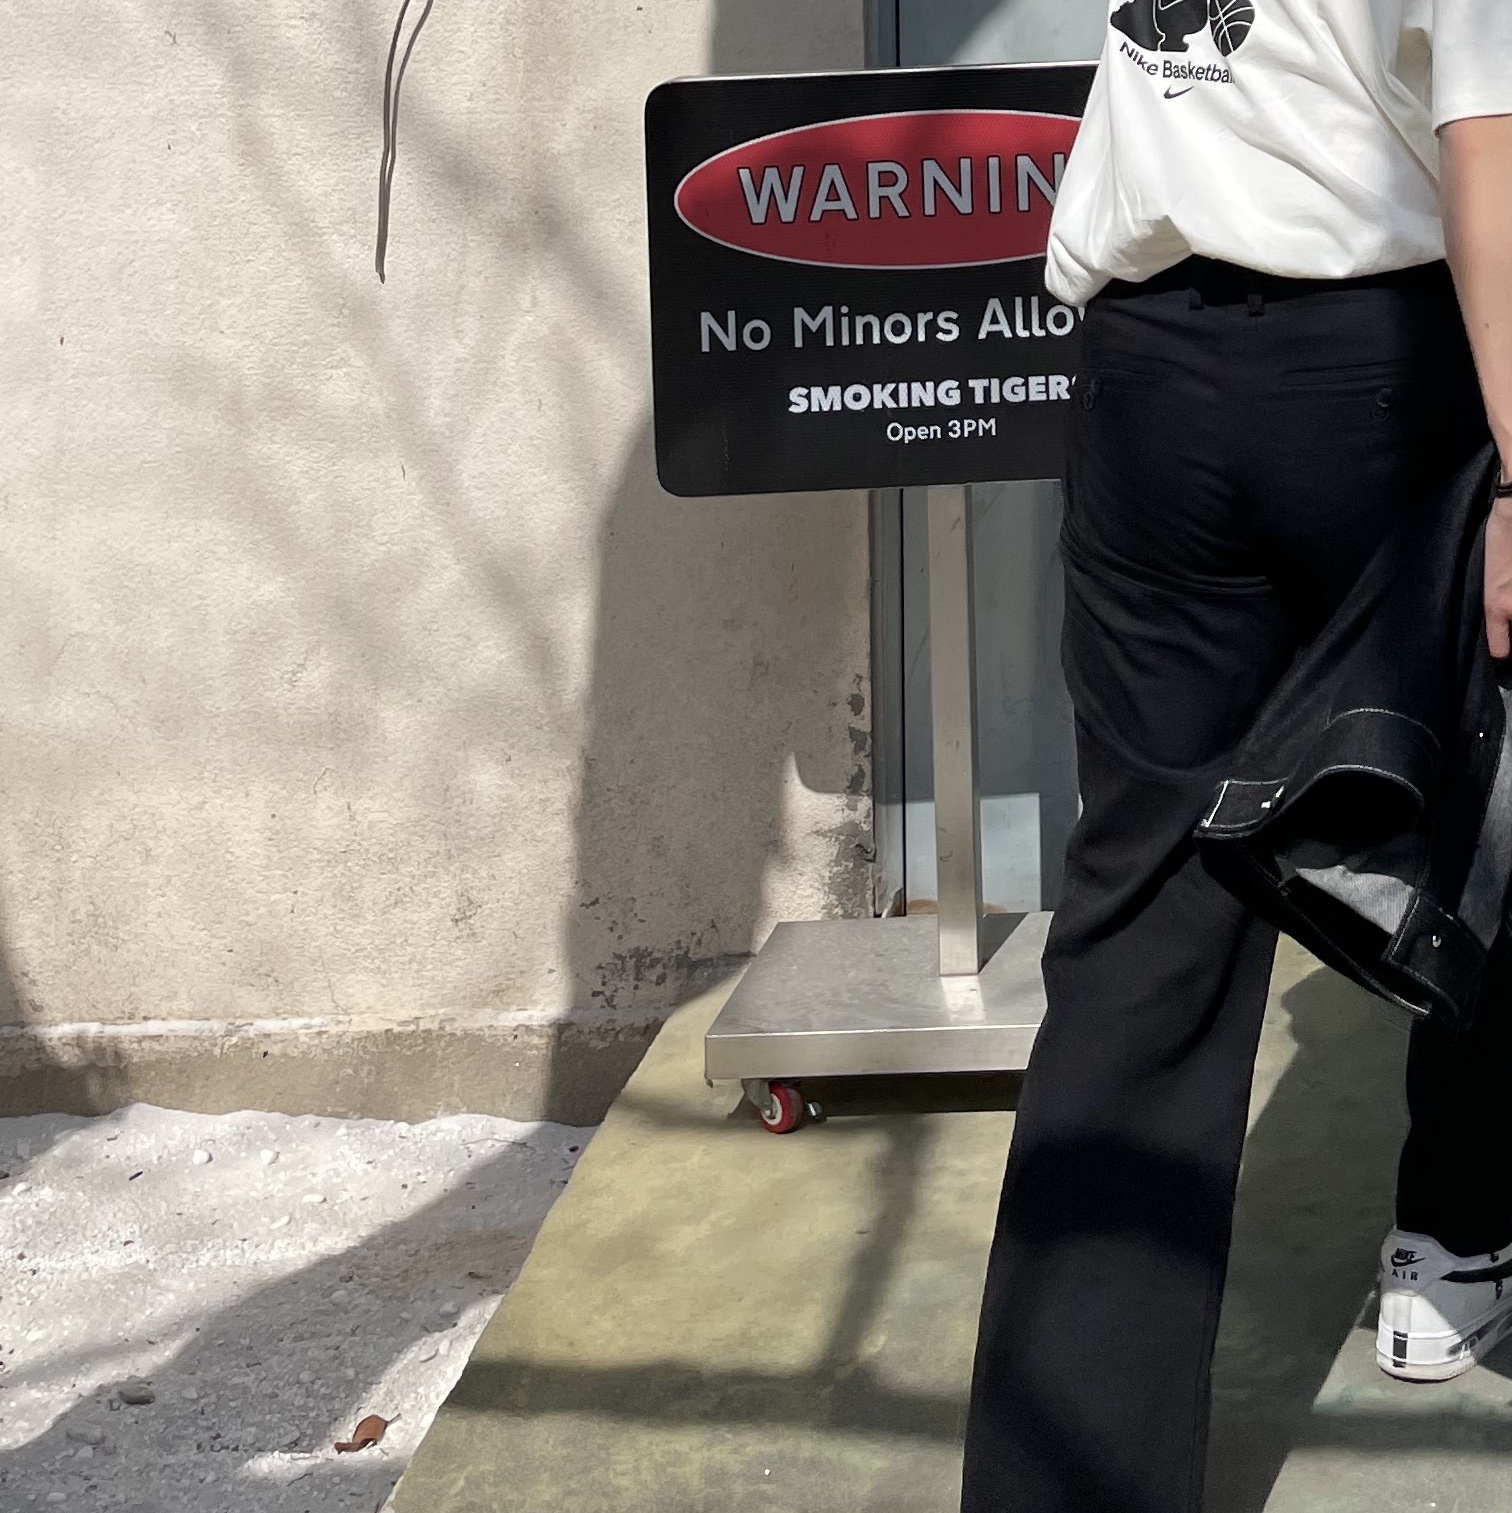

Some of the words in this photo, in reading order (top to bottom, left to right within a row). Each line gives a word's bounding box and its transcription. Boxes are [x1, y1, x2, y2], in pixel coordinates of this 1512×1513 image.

[1119, 40, 1160, 76] Nike
[736, 152, 1067, 226] WARNIN
[700, 310, 772, 353] No
[792, 304, 960, 349] Minors
[977, 295, 1085, 340] Allo
[787, 379, 960, 414] SMOKING
[967, 374, 1077, 405] TIGER
[885, 422, 942, 444] Open
[947, 417, 998, 440] 3PM
[1391, 1268, 1418, 1281] AIR
